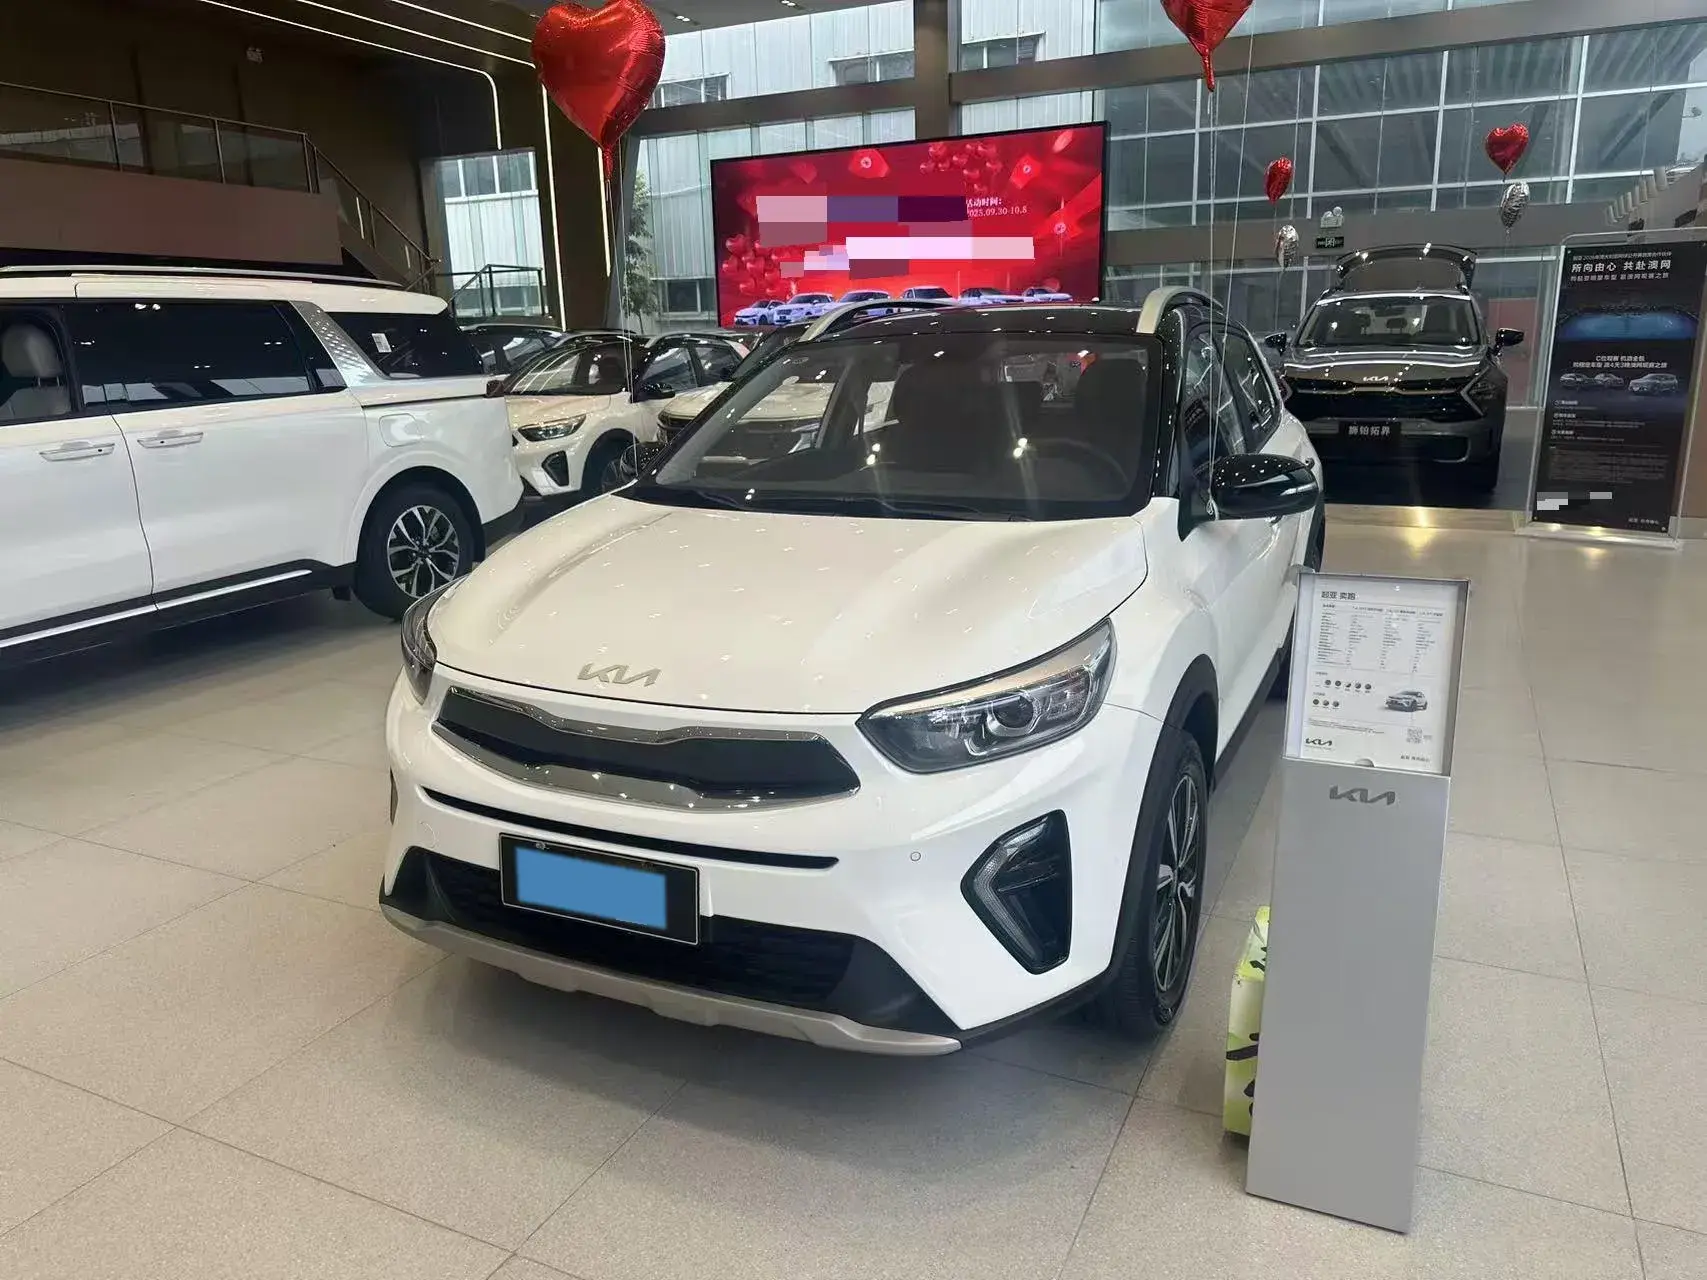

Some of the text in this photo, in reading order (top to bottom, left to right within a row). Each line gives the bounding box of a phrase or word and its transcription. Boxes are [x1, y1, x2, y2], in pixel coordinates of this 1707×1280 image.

[1571, 260, 1671, 273] 所向由心 共赴澳网
[1348, 425, 1391, 436] 狮铂拓界
[577, 662, 661, 687] KIA
[1329, 785, 1396, 805] KIA
